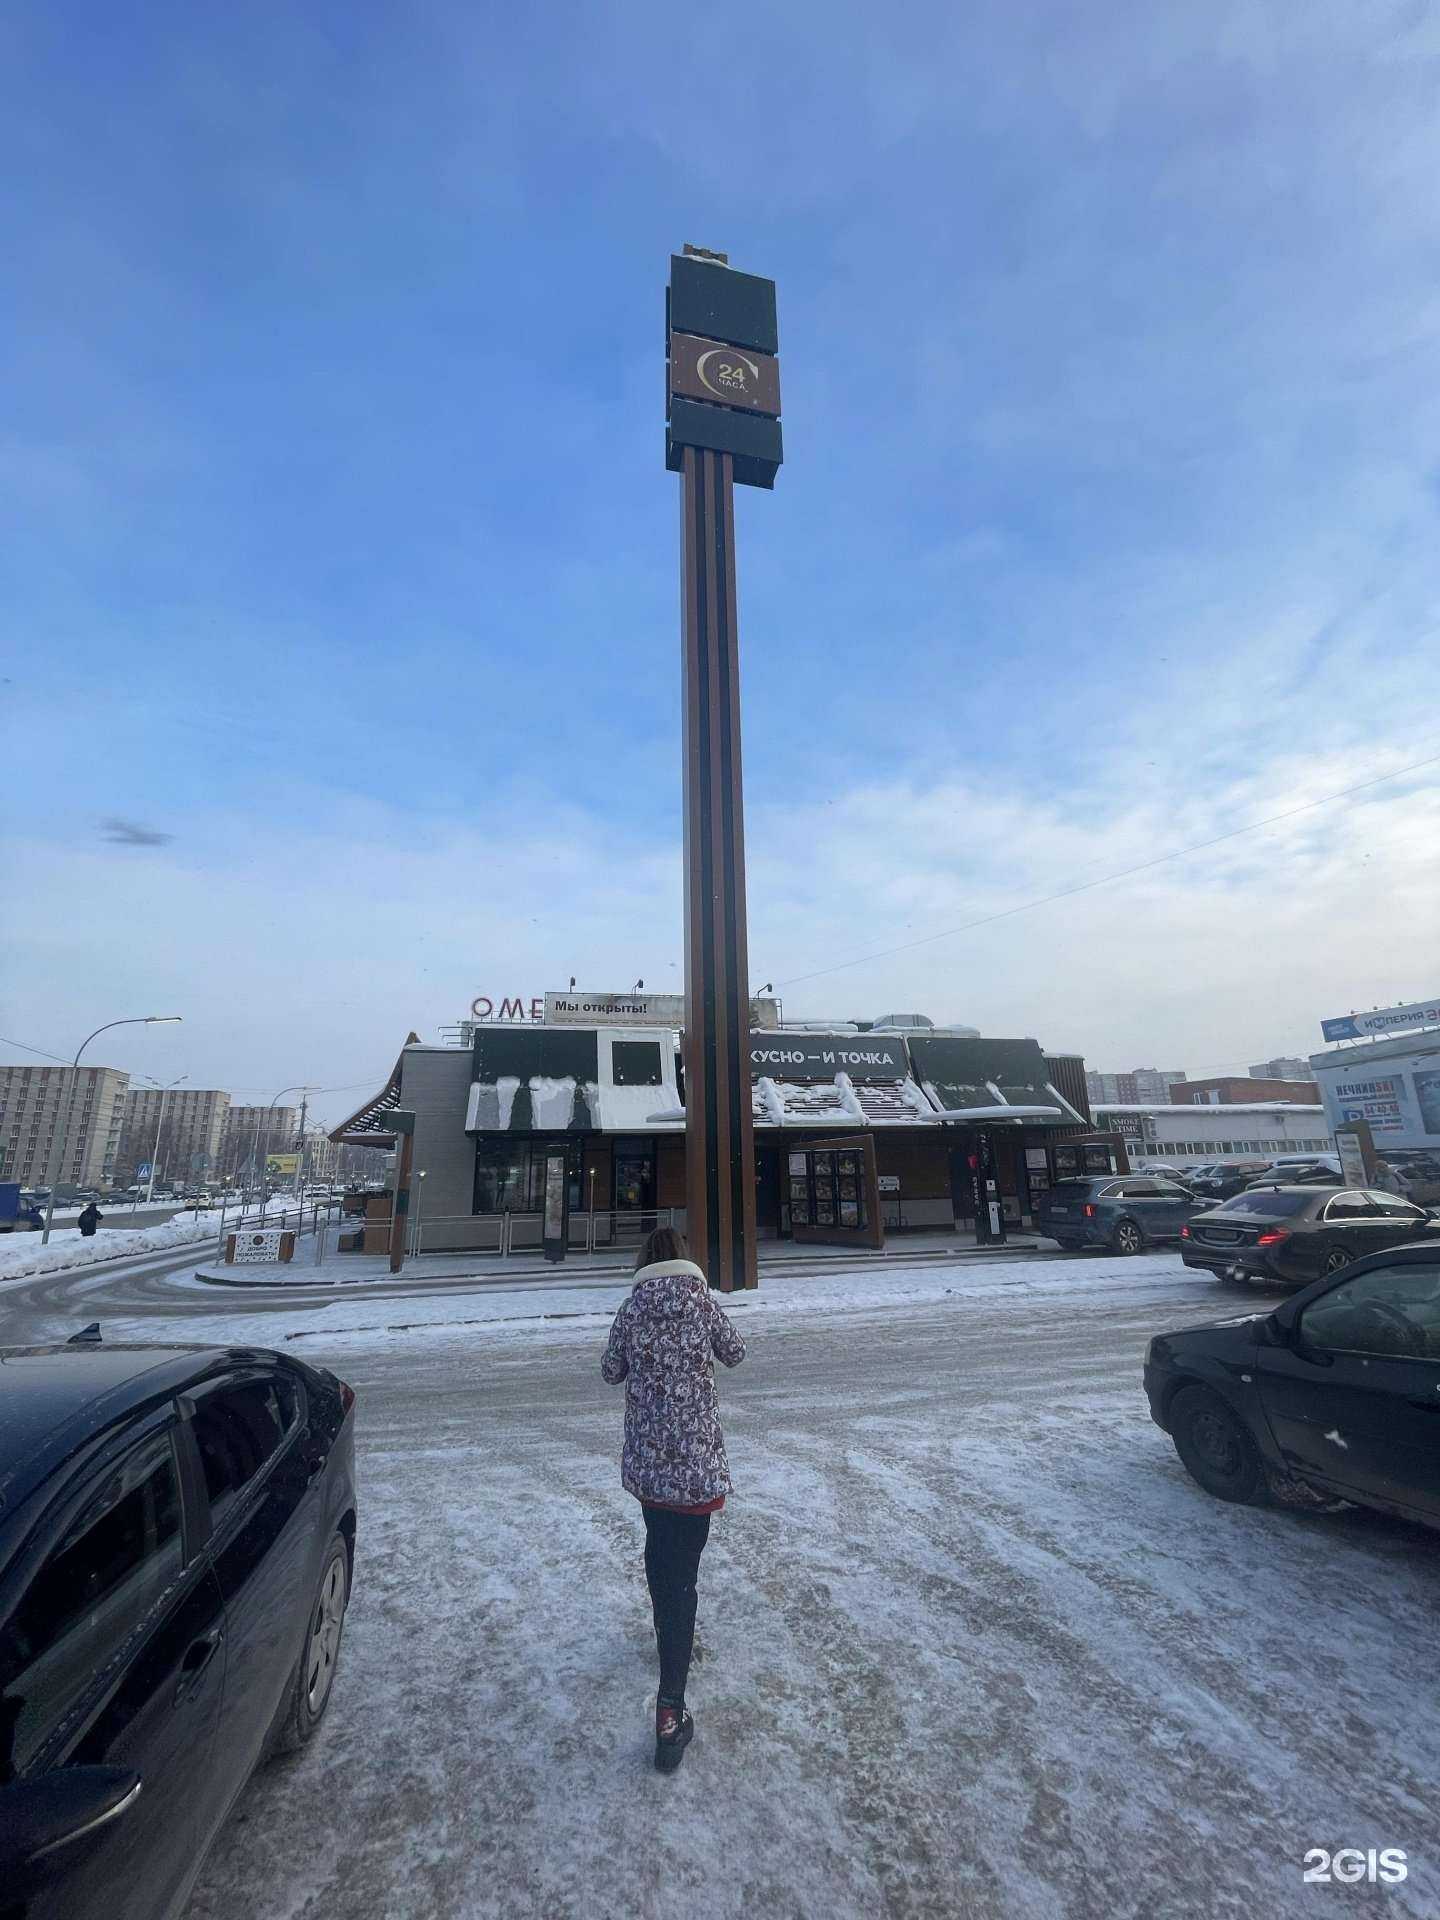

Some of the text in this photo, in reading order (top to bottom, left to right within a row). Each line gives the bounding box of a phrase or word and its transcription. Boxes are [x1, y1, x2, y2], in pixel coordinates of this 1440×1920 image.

[719, 364, 745, 382] 24
[555, 1000, 648, 1014] Мы открыты!
[822, 1051, 835, 1064] И
[838, 1051, 894, 1065] ТОЧКА
